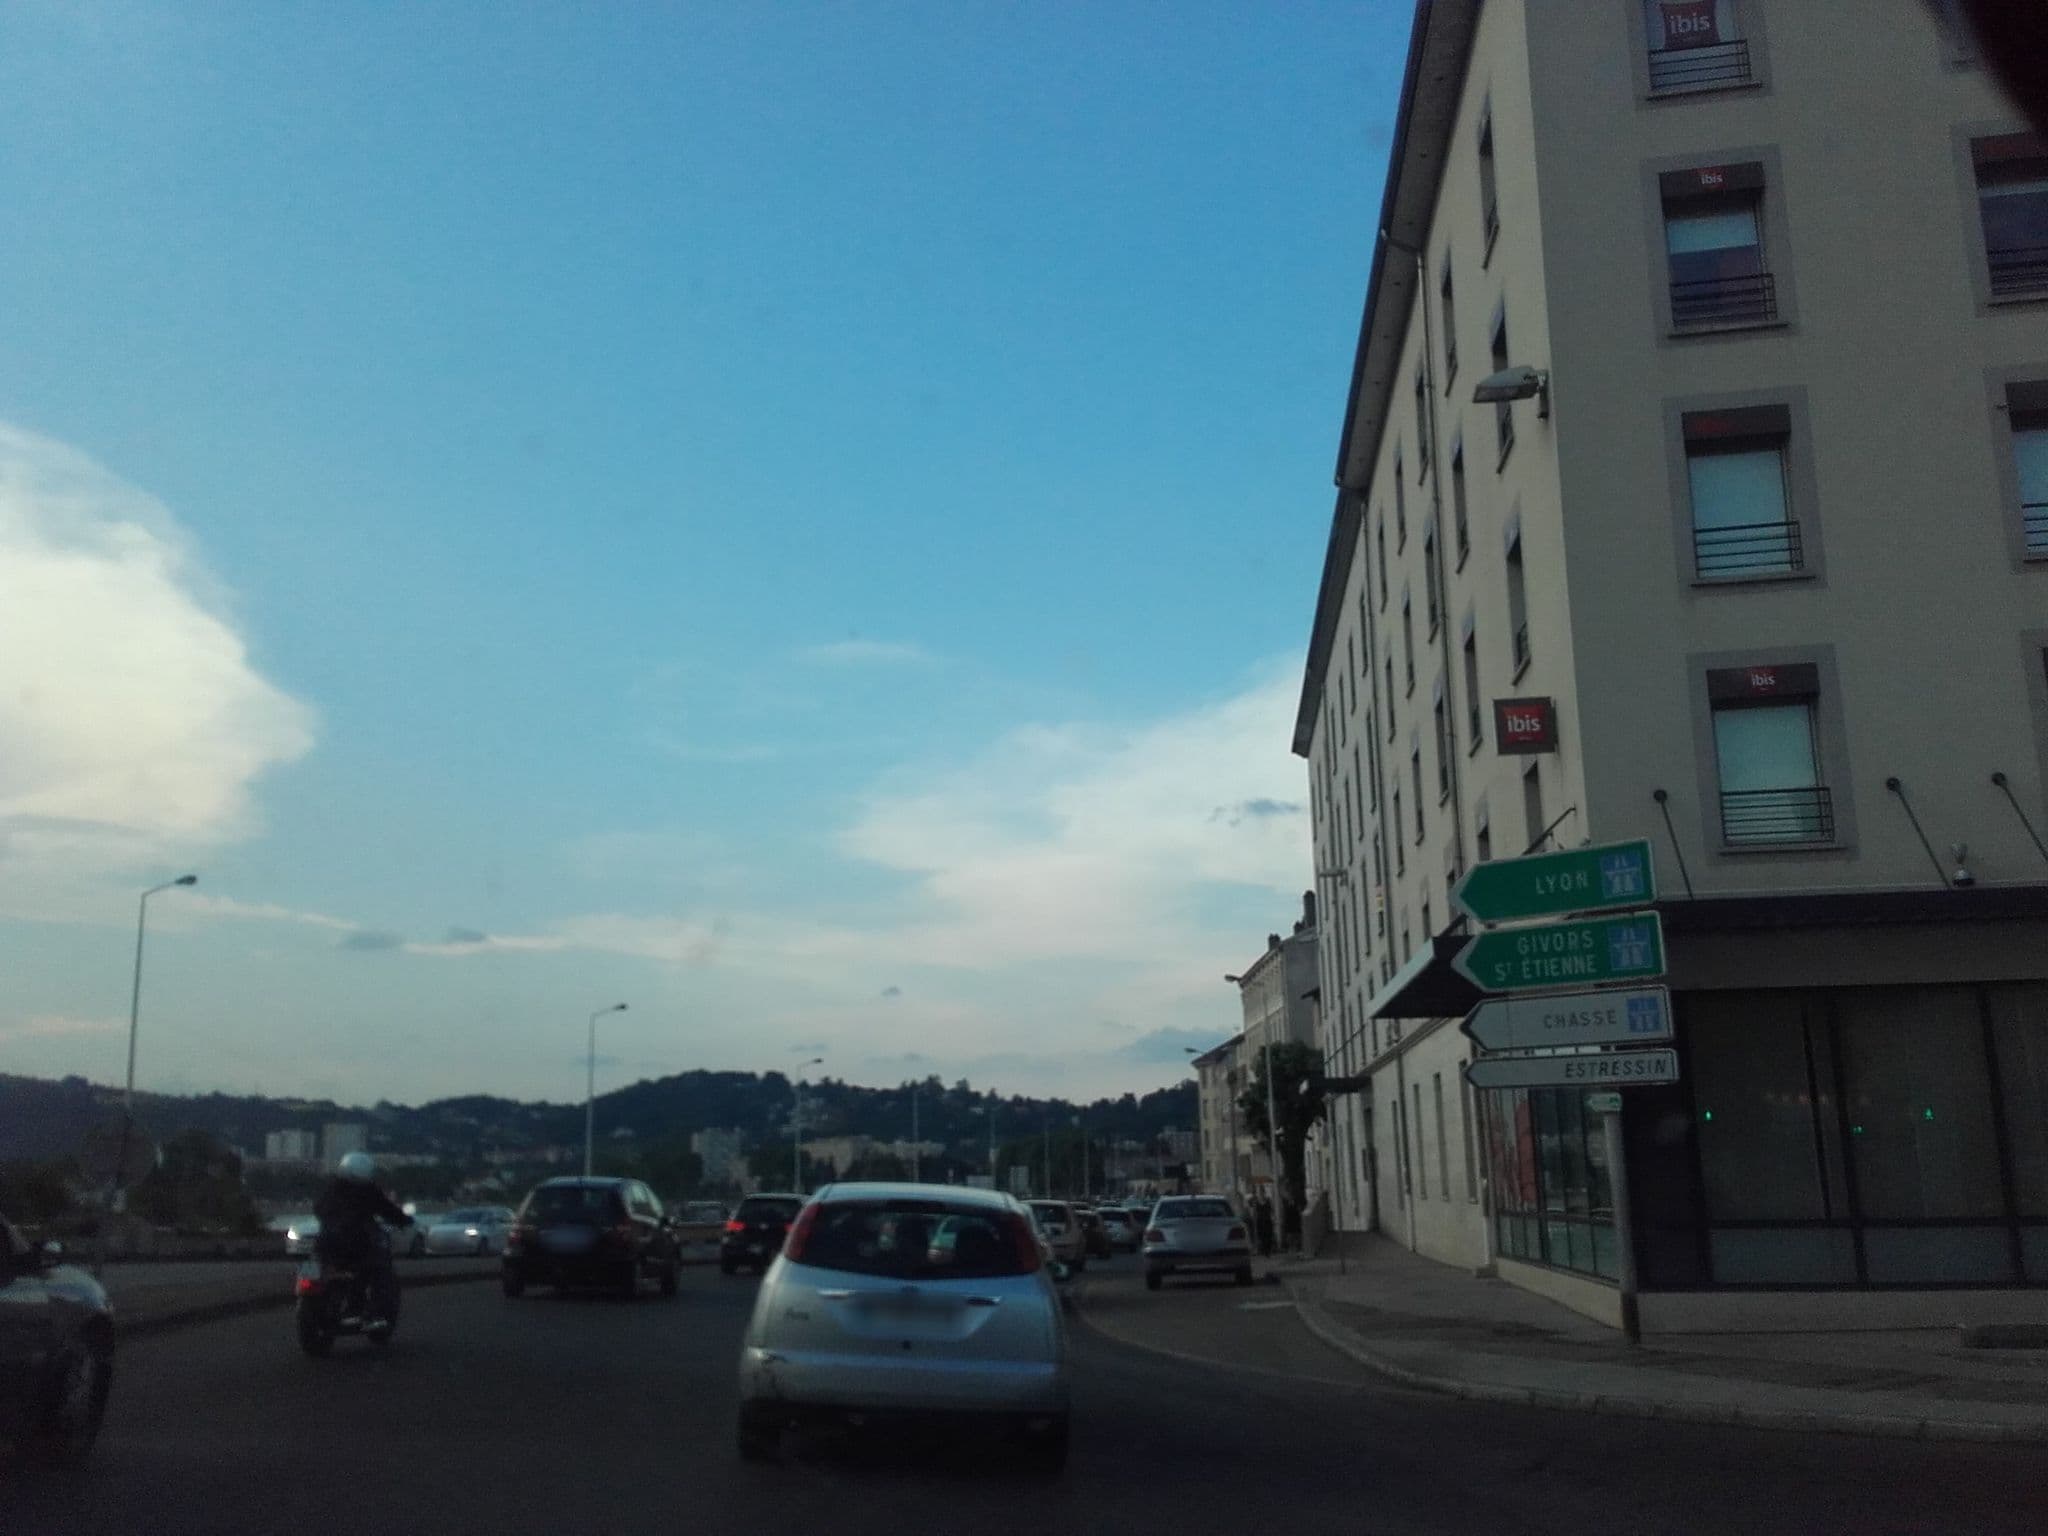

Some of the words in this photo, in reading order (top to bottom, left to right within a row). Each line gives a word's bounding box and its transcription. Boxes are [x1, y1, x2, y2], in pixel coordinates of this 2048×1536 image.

[1671, 13, 1709, 33] ibis
[1701, 173, 1723, 185] ibis
[1752, 674, 1775, 686] ibis
[1507, 714, 1541, 733] ibis
[1535, 870, 1588, 894] LYON
[1517, 930, 1593, 955] GIVORS
[1544, 1009, 1617, 1030] CHASSE
[1565, 1059, 1667, 1079] ESTRESSIN
